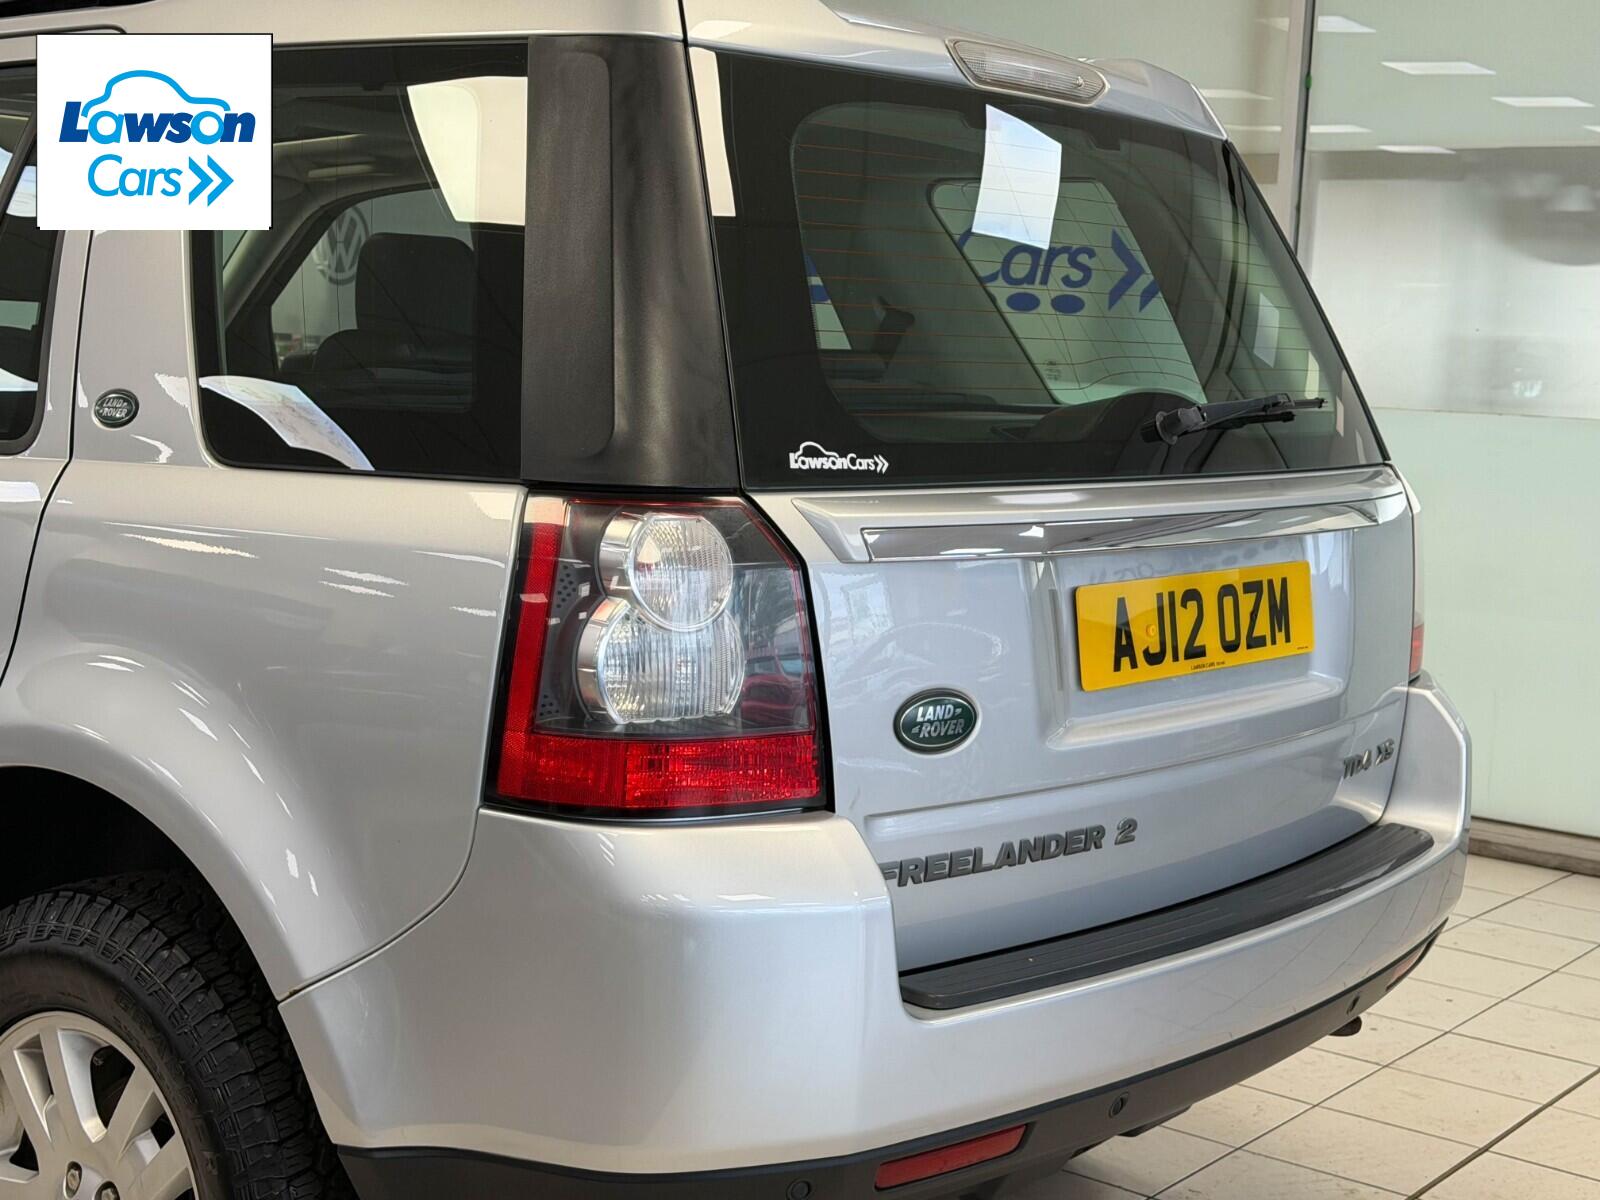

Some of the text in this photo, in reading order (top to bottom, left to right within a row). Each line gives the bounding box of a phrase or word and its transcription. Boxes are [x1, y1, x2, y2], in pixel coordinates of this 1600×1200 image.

[1112, 576, 1291, 673] AJ12 OZM
[916, 704, 954, 722] LAND
[919, 718, 965, 739] ROVER
[1114, 817, 1139, 846] 2
